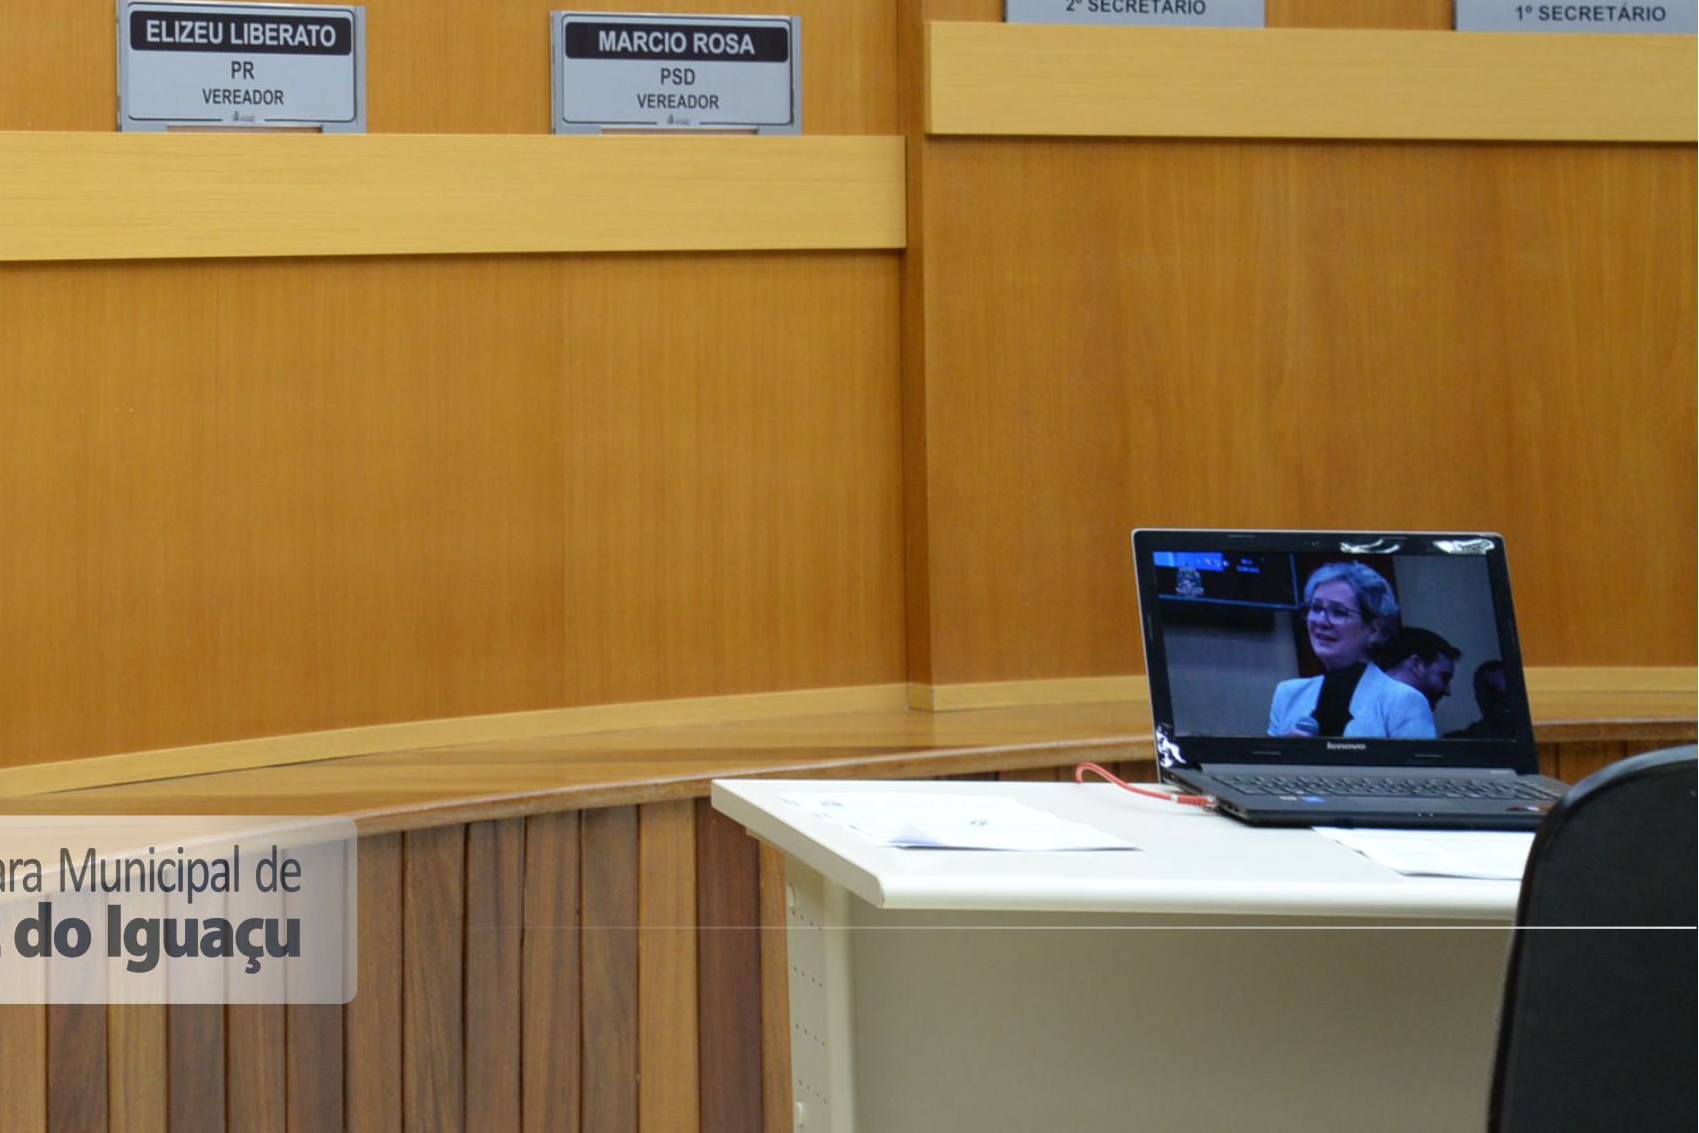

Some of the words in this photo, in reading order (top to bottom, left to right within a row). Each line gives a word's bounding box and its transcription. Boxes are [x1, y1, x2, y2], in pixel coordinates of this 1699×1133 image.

[1538, 1, 1667, 23] SECRETÁRIO
[145, 19, 224, 45] ELIZEU
[230, 22, 337, 48] LIBERATO
[598, 30, 687, 53] MARCIO
[693, 32, 756, 55] ROSA
[230, 60, 255, 80] PR
[660, 67, 696, 86] PSD
[201, 88, 285, 106] VEREADOR
[636, 93, 720, 110] VEREADOR
